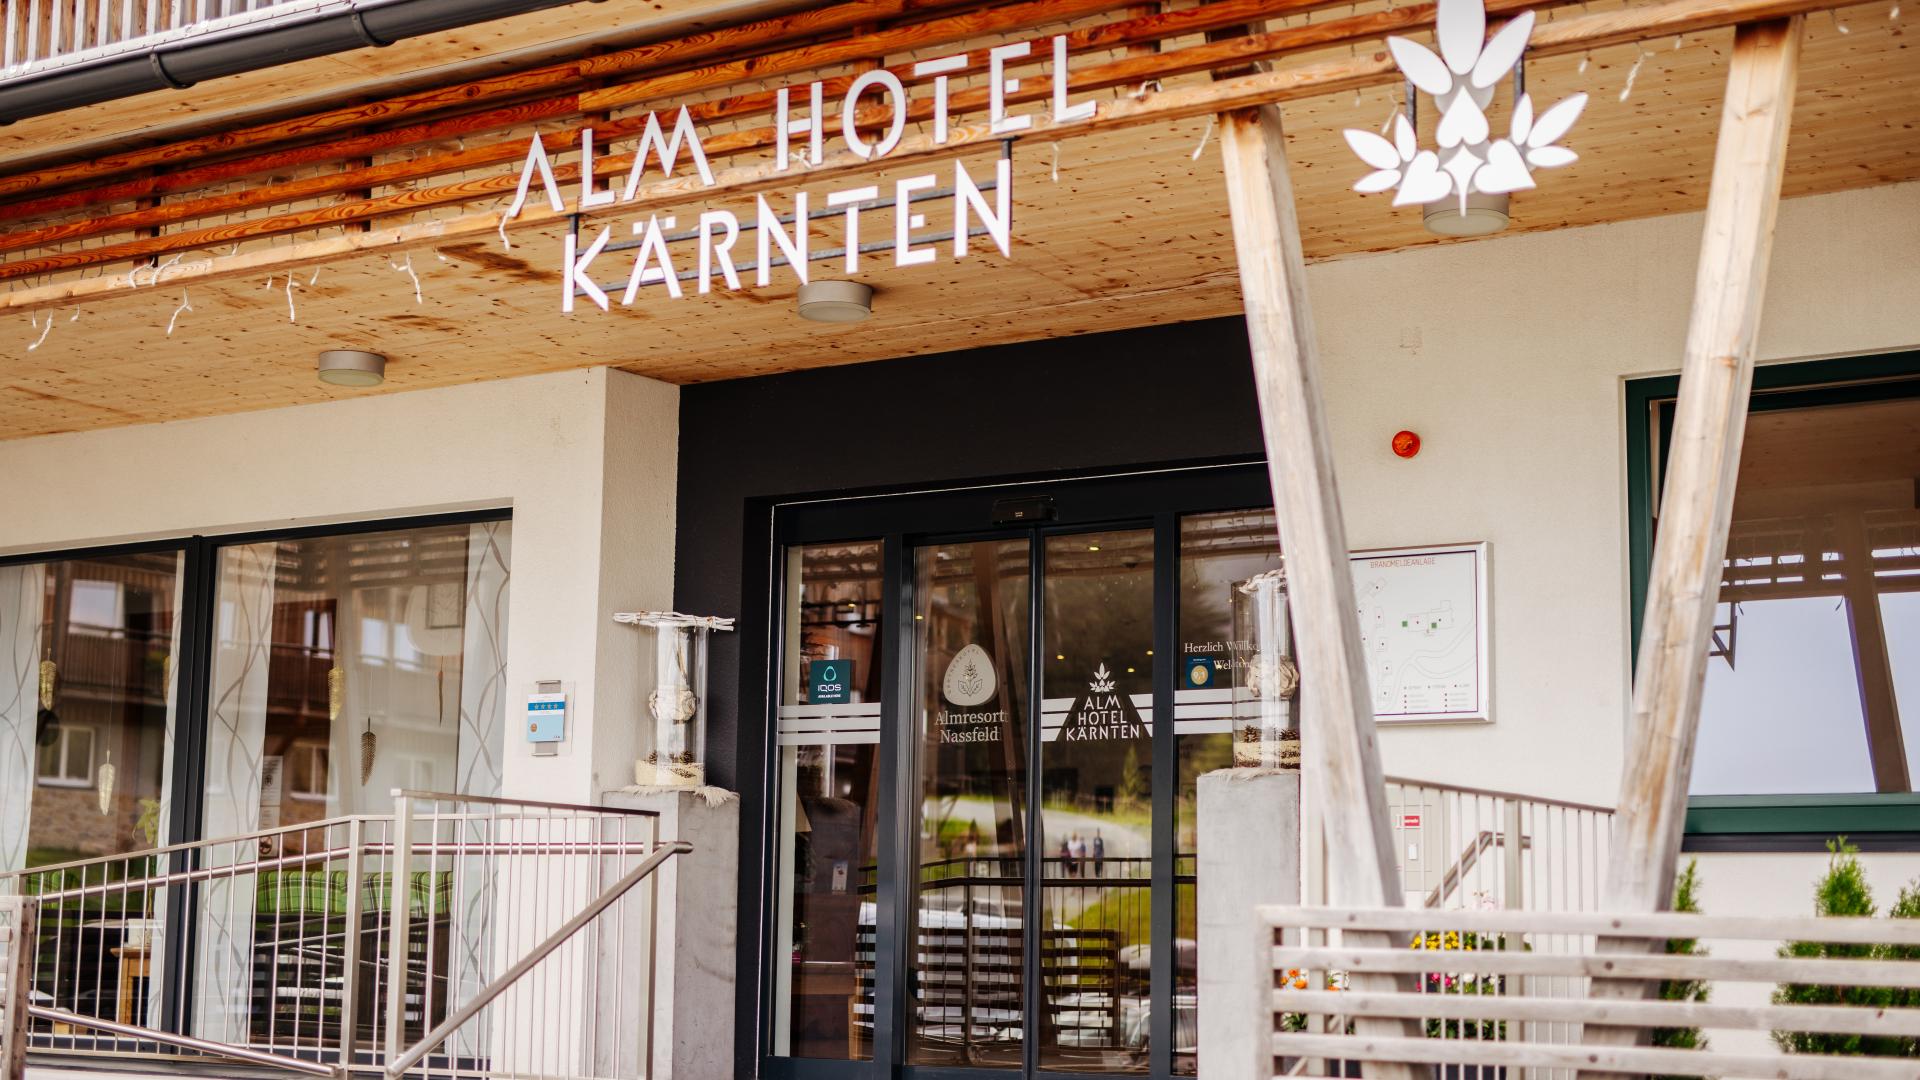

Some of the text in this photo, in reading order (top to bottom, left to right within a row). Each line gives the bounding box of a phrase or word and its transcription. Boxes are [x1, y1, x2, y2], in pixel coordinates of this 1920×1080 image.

[509, 35, 1096, 217] ALM HOTEL
[562, 158, 1012, 313] KÄRNTEN
[1184, 641, 1224, 653] Herzlich
[817, 684, 842, 692] IQOS
[1083, 694, 1121, 710] ALM
[934, 709, 1006, 725] Almresort
[1078, 710, 1127, 726] HOTEL
[940, 726, 1000, 743] Nassfeld
[1066, 724, 1140, 741] KÄRNTEN
